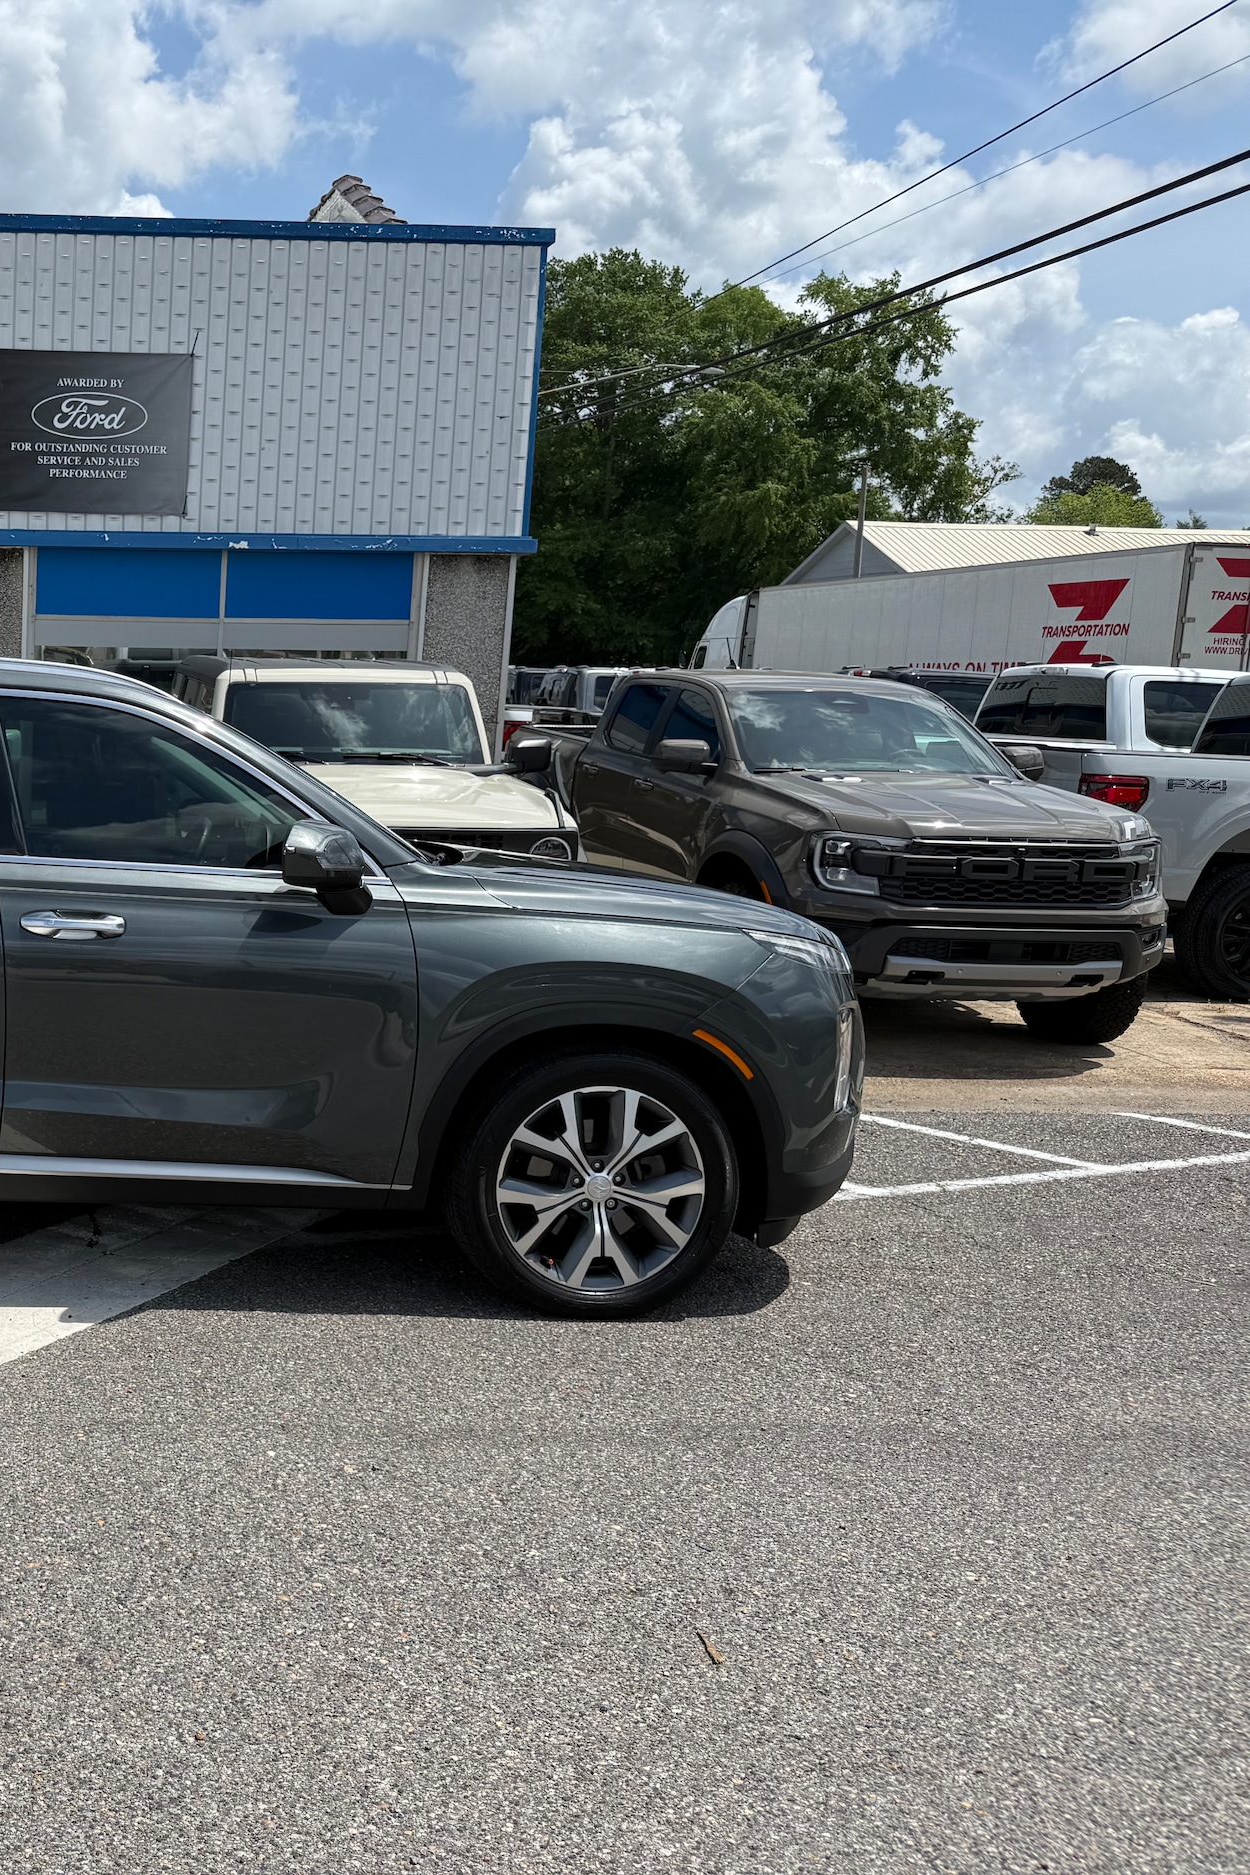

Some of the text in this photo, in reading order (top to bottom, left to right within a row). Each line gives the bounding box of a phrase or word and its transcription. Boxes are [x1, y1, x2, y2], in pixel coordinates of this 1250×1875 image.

[56, 378, 125, 388] AWARDED BY
[53, 397, 127, 430] Ford
[10, 442, 168, 455] FOR OUTSTANDING CUSTOMER
[37, 455, 140, 467] SERVICE AND SALES
[49, 468, 128, 480] PERFORMANCE
[1041, 623, 1130, 639] TRANSPORTATION
[1166, 778, 1227, 792] FX4
[896, 855, 1136, 882] FORD
